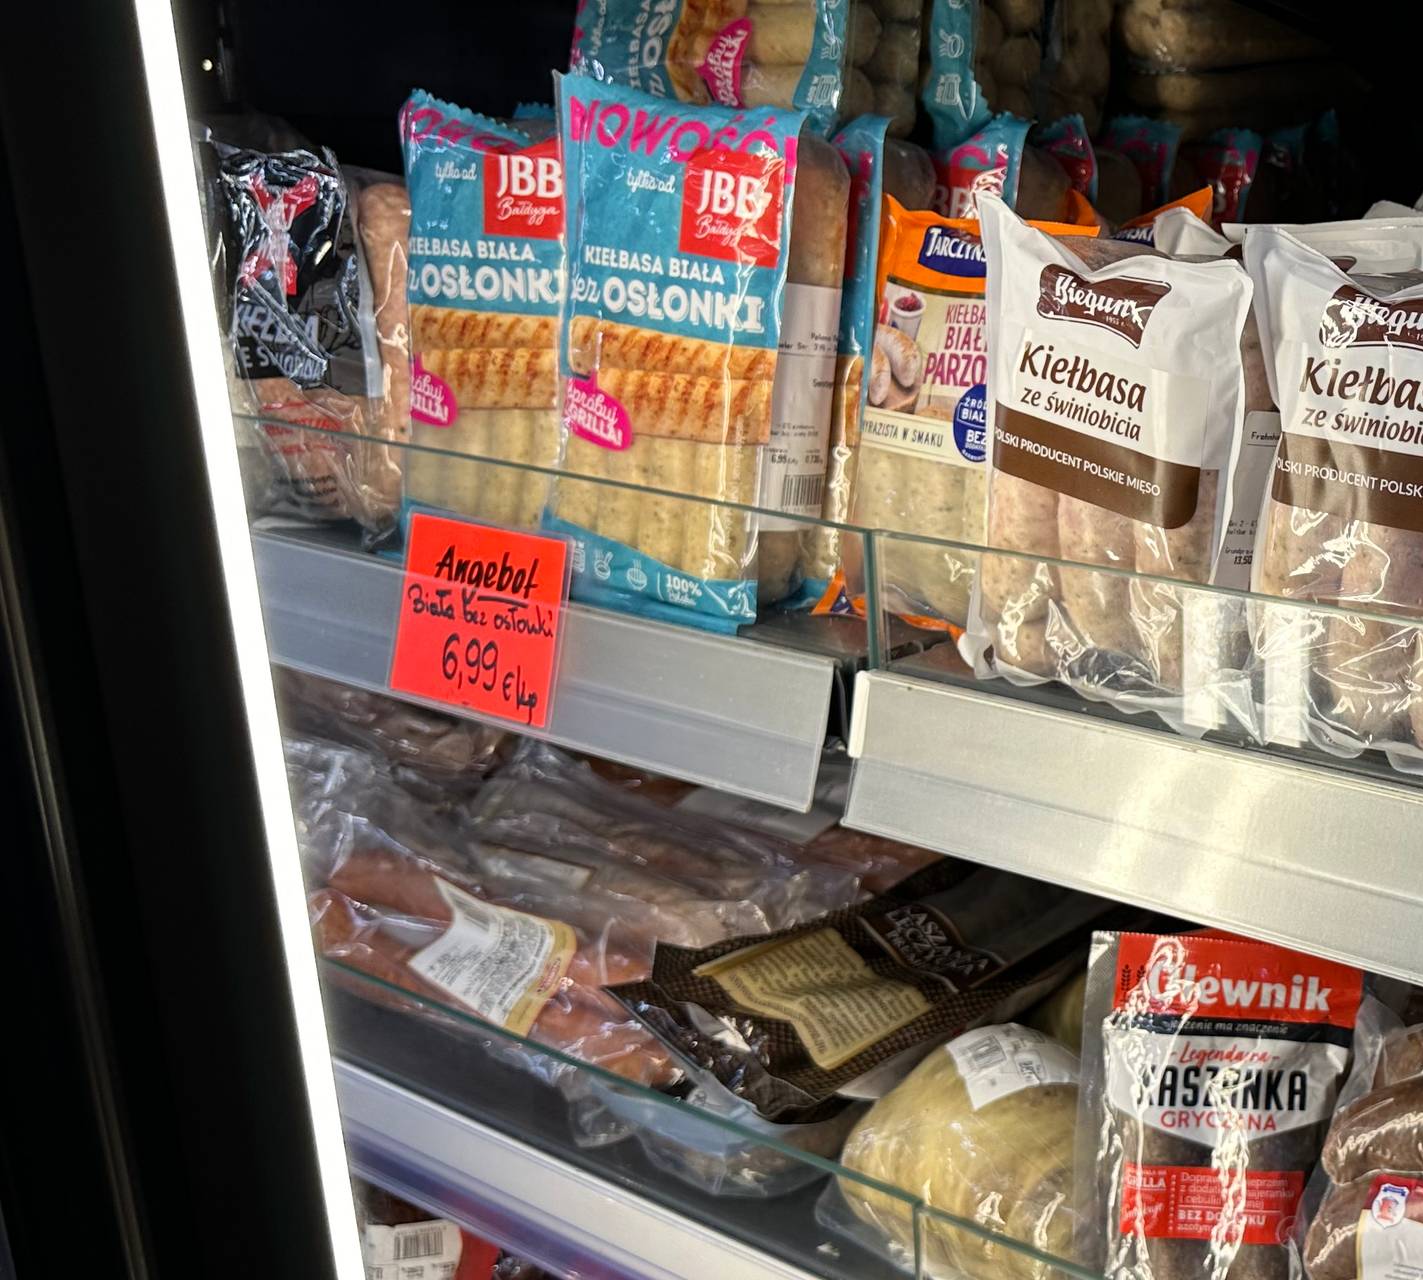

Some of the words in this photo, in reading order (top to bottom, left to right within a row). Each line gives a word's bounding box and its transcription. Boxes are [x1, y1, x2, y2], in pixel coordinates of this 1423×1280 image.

[496, 154, 563, 199] JBB
[695, 168, 768, 221] JBB
[695, 214, 757, 247] Bałdyg
[477, 239, 535, 262] BIAŁA
[584, 244, 665, 276] KIEŁBASA
[668, 256, 726, 286] BIAŁA
[602, 276, 766, 333] OSŁONKI
[945, 303, 987, 325] KIEŁBA
[943, 327, 987, 350] BIAŁ
[923, 354, 987, 388] PARZO
[1019, 343, 1147, 414] Kiełbasa
[960, 407, 986, 423] BIAŁ
[1020, 385, 1042, 407] ze
[1044, 389, 1142, 442] świniobicia
[1301, 406, 1327, 428] ze
[861, 421, 900, 442] YRAZISTA
[911, 430, 944, 449] SMAKU
[1020, 437, 1082, 470] PRODUCENT
[1083, 454, 1124, 484] POLSKIE
[1125, 478, 1160, 498] MIĘSO
[1275, 455, 1303, 476] OLSKI
[1304, 463, 1379, 491] PRODUCENT
[434, 544, 541, 600] Angebot
[665, 573, 702, 597] 100%
[406, 582, 456, 622] Biała
[460, 587, 489, 628] bez
[441, 632, 500, 692] 6,99
[1160, 1109, 1277, 1132] GRYCNA
